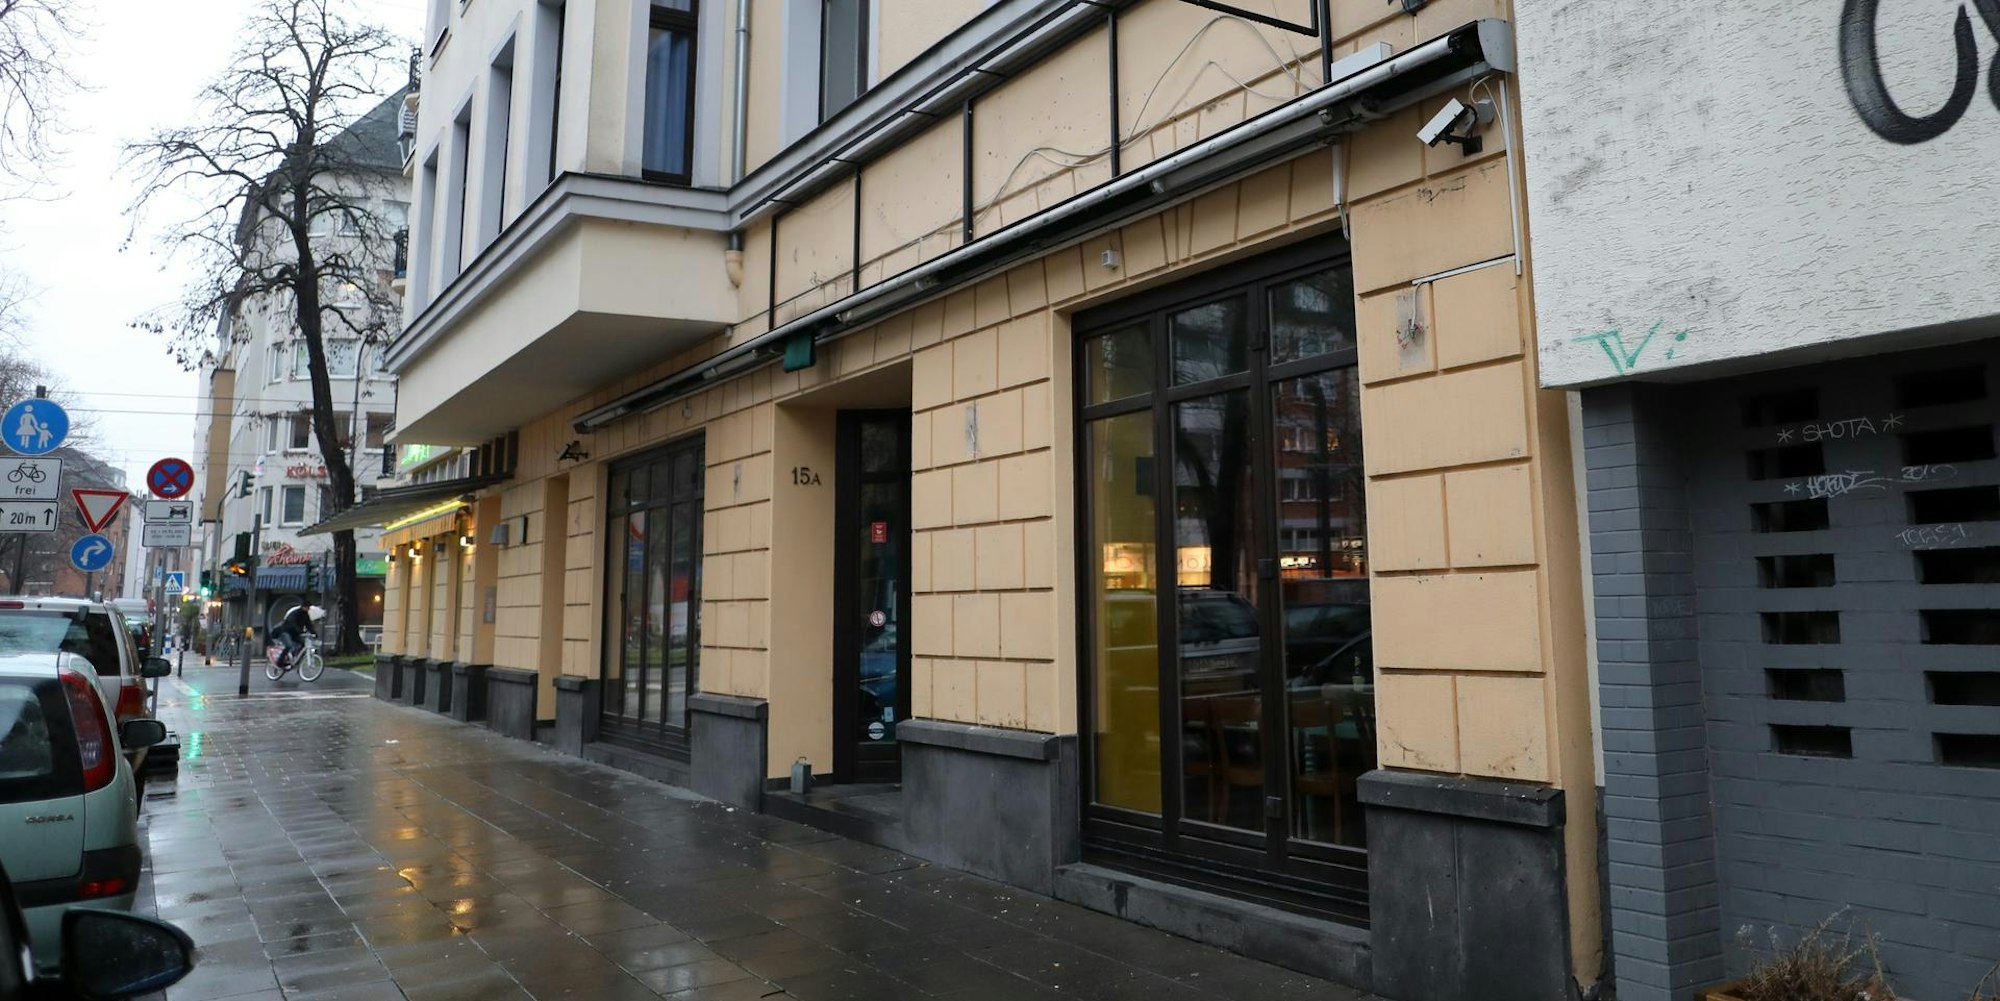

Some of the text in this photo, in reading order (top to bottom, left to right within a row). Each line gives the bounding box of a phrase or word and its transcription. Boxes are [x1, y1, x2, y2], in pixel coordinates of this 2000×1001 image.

[1802, 417, 1877, 442] SHOTA
[792, 466, 821, 486] 15A
[15, 485, 36, 495] frei
